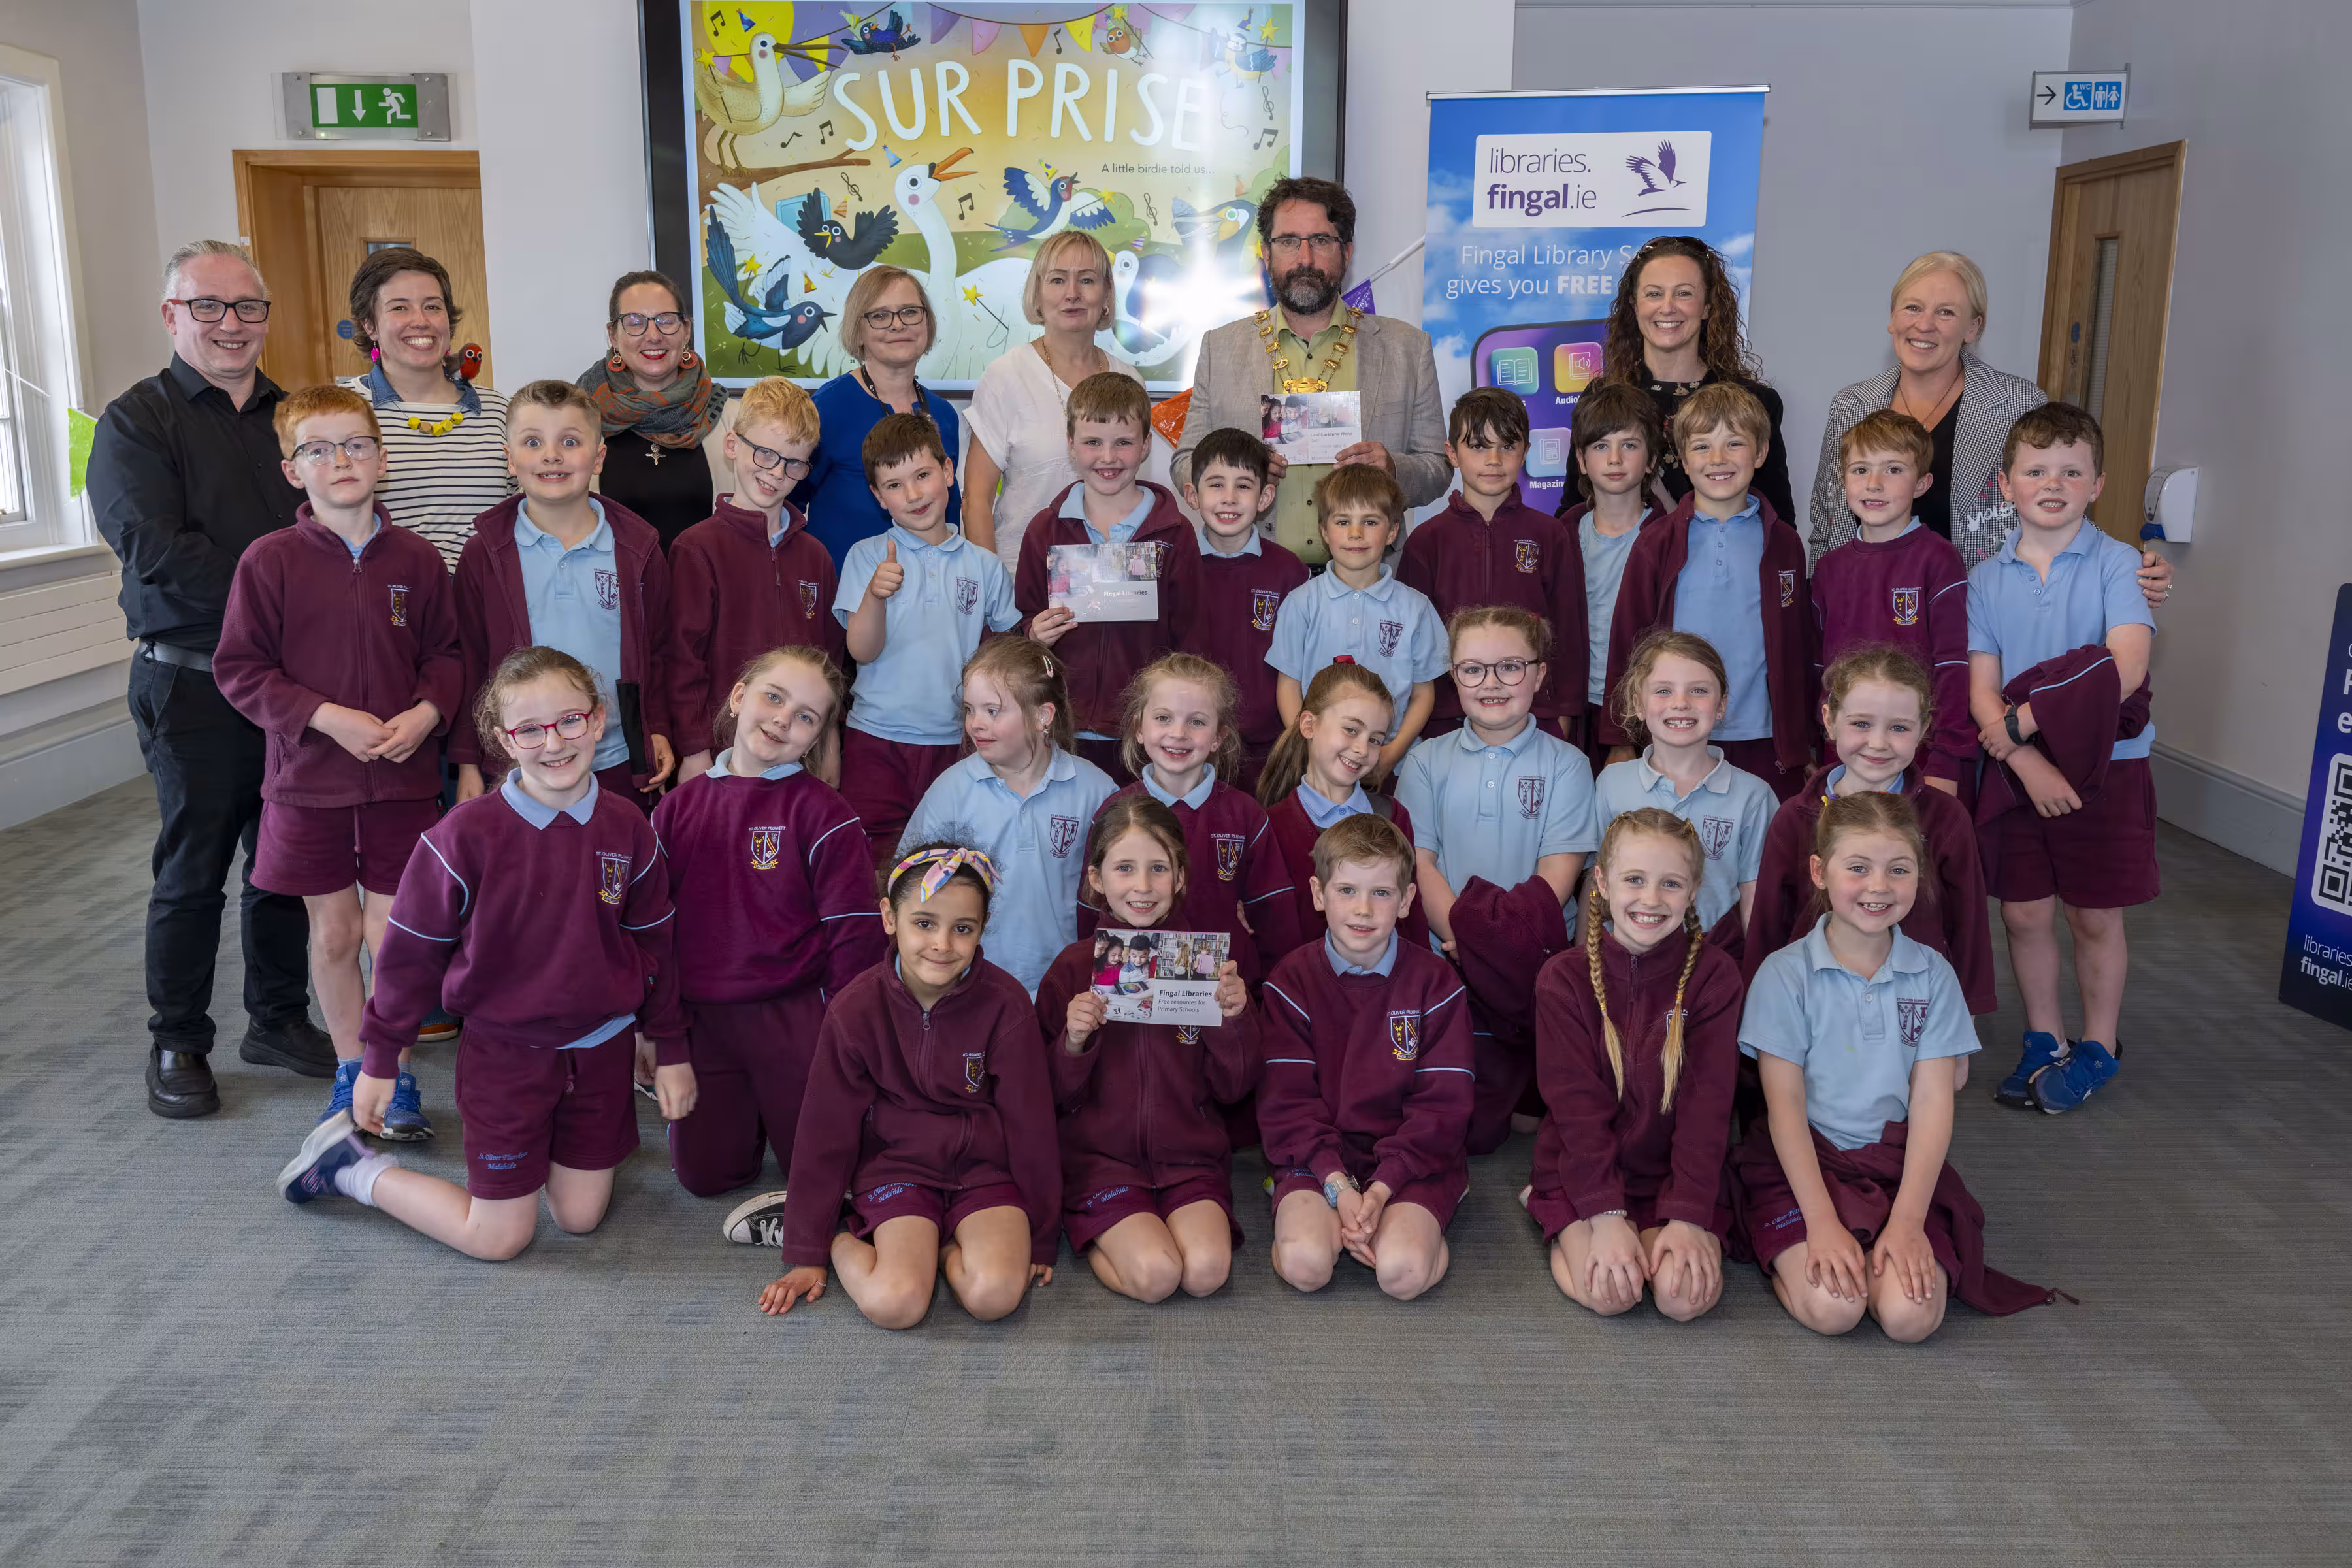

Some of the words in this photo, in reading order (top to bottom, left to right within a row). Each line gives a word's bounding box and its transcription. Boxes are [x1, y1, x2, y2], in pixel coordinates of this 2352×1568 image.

[833, 60, 982, 151] SUR
[1007, 59, 1208, 152] PRISE
[1101, 163, 1109, 173] A
[1113, 163, 1134, 173] little
[1138, 163, 1167, 173] birdie
[1171, 163, 1190, 174] told
[1490, 147, 1591, 174] libraries.
[1487, 183, 1597, 216] fingal.ie
[1462, 244, 1525, 270] Fingal
[1534, 244, 1613, 270] Library
[1446, 275, 1501, 299] gives
[1507, 280, 1548, 299] you
[1558, 275, 1612, 294] FREE
[1555, 395, 1580, 404] Audio
[1529, 480, 1565, 489] Magazin
[2304, 934, 2352, 966] libraries
[874, 1184, 888, 1196] Oliver
[879, 1186, 904, 1203] Malahide
[1101, 1186, 1130, 1203] Malahide
[1772, 1213, 1788, 1224] Oliver
[1776, 1216, 1802, 1230] Malahide
